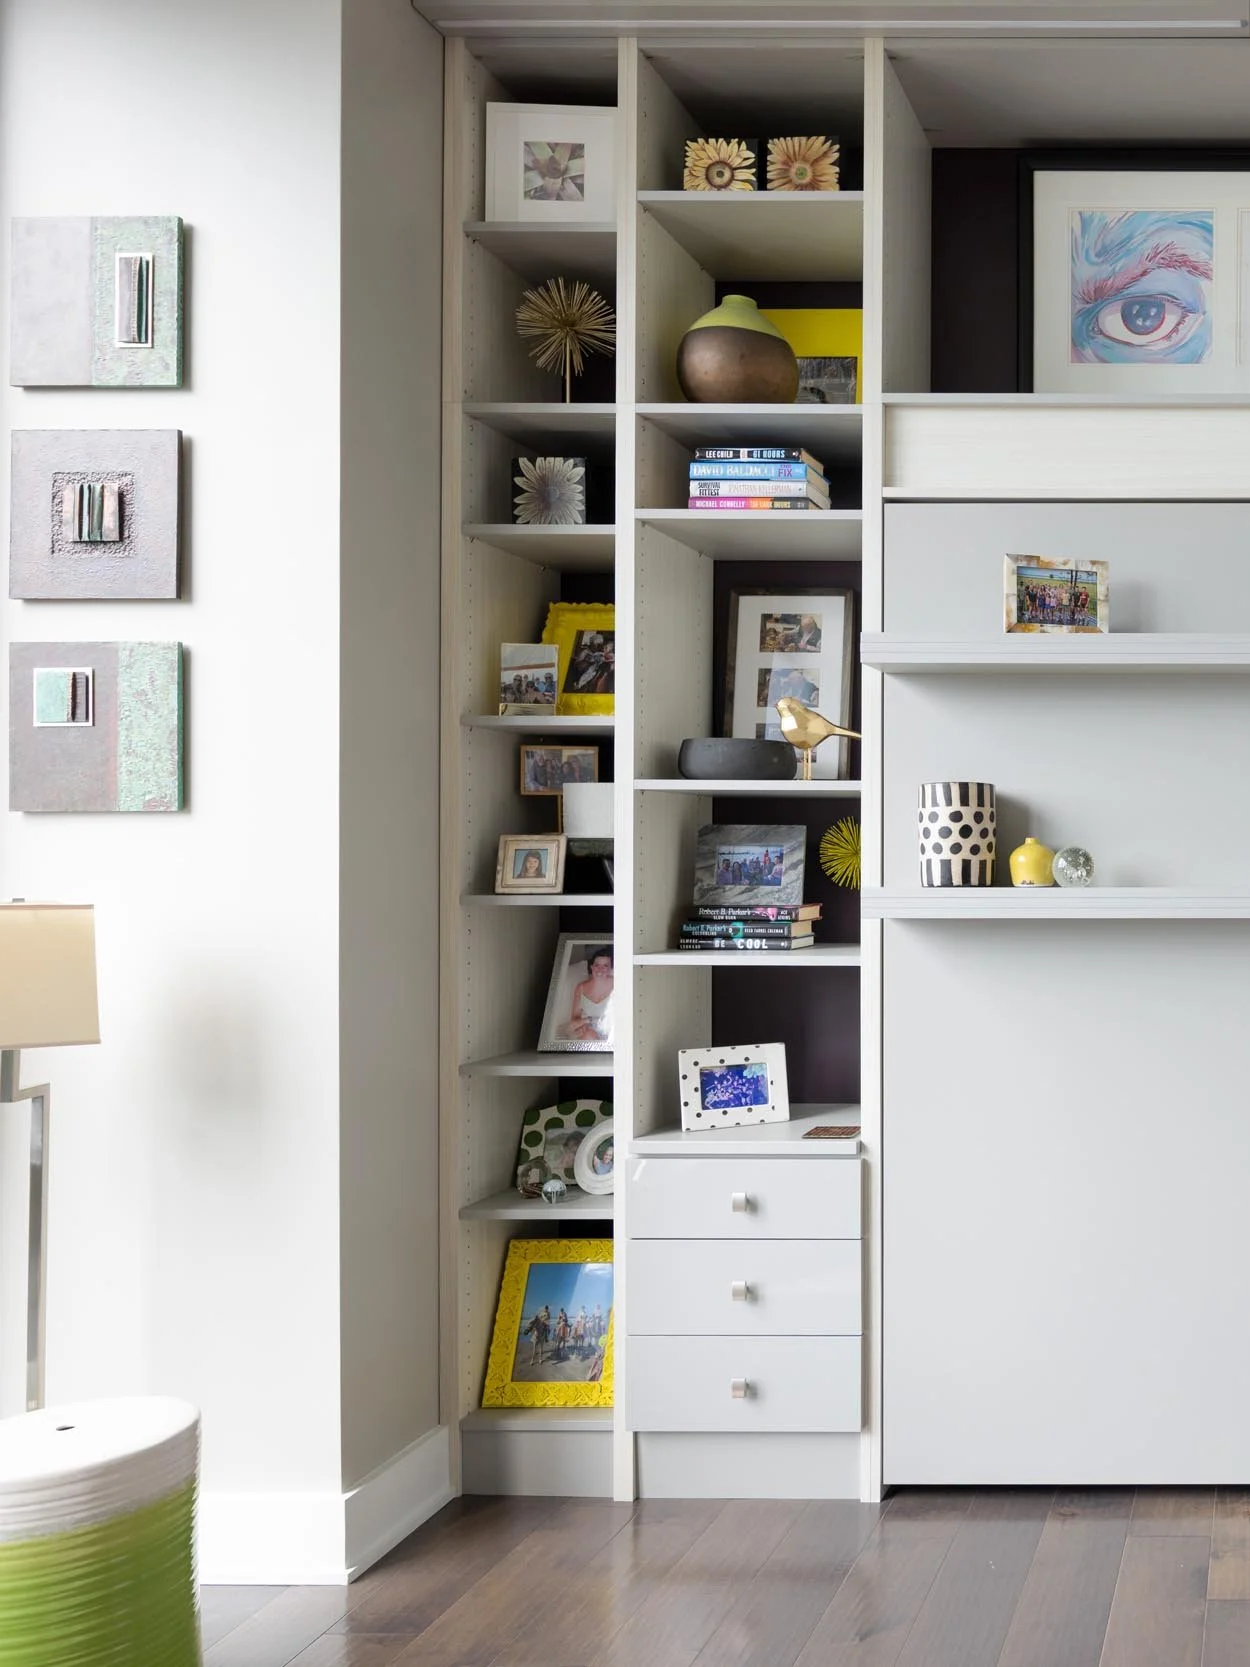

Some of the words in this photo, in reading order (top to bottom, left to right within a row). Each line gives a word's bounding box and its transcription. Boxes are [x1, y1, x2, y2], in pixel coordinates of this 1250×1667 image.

[705, 450, 717, 458] LEE
[717, 450, 733, 458] CHILD
[762, 449, 785, 458] HOURS
[693, 464, 723, 477] DAVID
[726, 464, 775, 477] BALDACCI
[778, 468, 793, 478] FIX
[697, 481, 721, 489] SURVIVAL
[698, 488, 720, 496] FITTEST
[695, 500, 718, 508] MICHAEL
[719, 500, 746, 508] CONNELLY
[698, 907, 719, 916] Robert
[682, 923, 699, 932] Robert
[714, 939, 726, 948] BE
[737, 938, 768, 949] COOL
